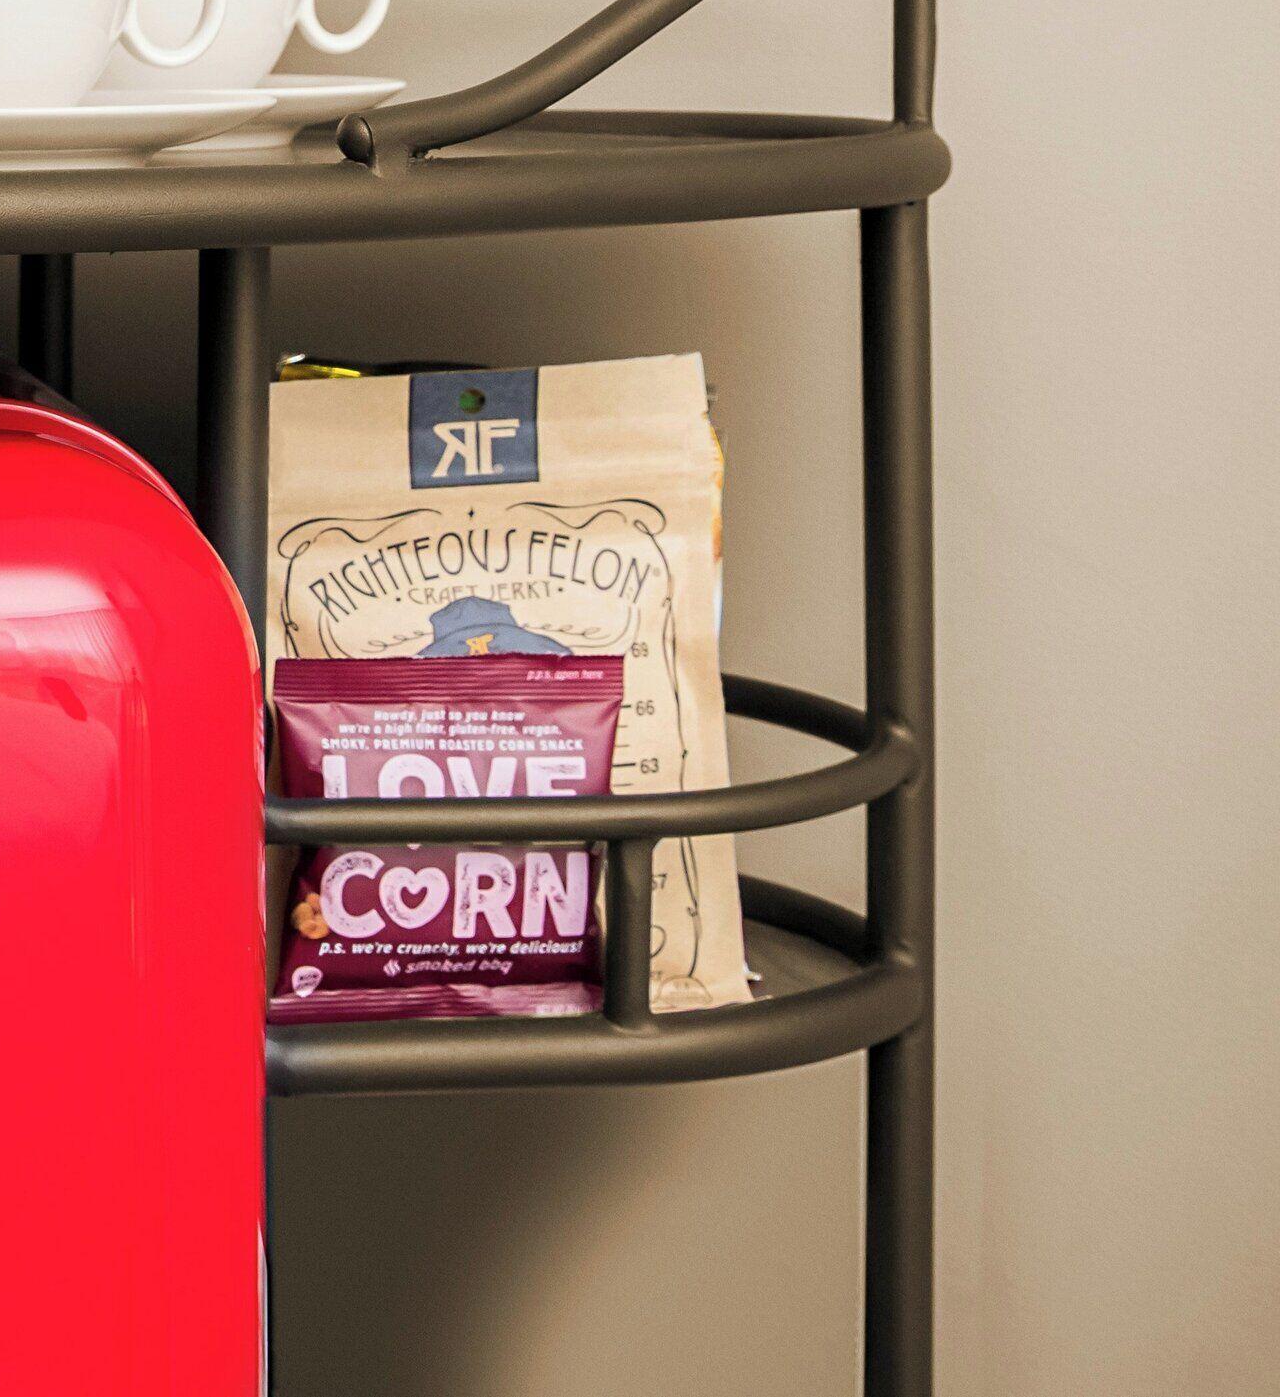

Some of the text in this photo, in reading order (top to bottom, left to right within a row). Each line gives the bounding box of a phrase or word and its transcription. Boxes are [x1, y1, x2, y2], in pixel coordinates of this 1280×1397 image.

[308, 528, 651, 622] RIGHTEOUS FELON
[408, 580, 551, 604] CRAFT JERKY
[631, 643, 649, 657] 69
[635, 700, 655, 715] 66
[421, 708, 446, 722] just
[448, 711, 462, 721] so
[465, 711, 488, 723] you
[491, 709, 526, 721] know
[384, 723, 413, 736] high
[374, 738, 435, 750] PREMIUM
[439, 739, 495, 751] ROASTED
[499, 739, 535, 751] CORN
[540, 739, 584, 751] SNACK
[640, 759, 659, 774] 63
[320, 851, 590, 938] CORN
[318, 940, 583, 957] p.s. we're crunchy, we're delicious!
[405, 958, 513, 975] smoked bbq
